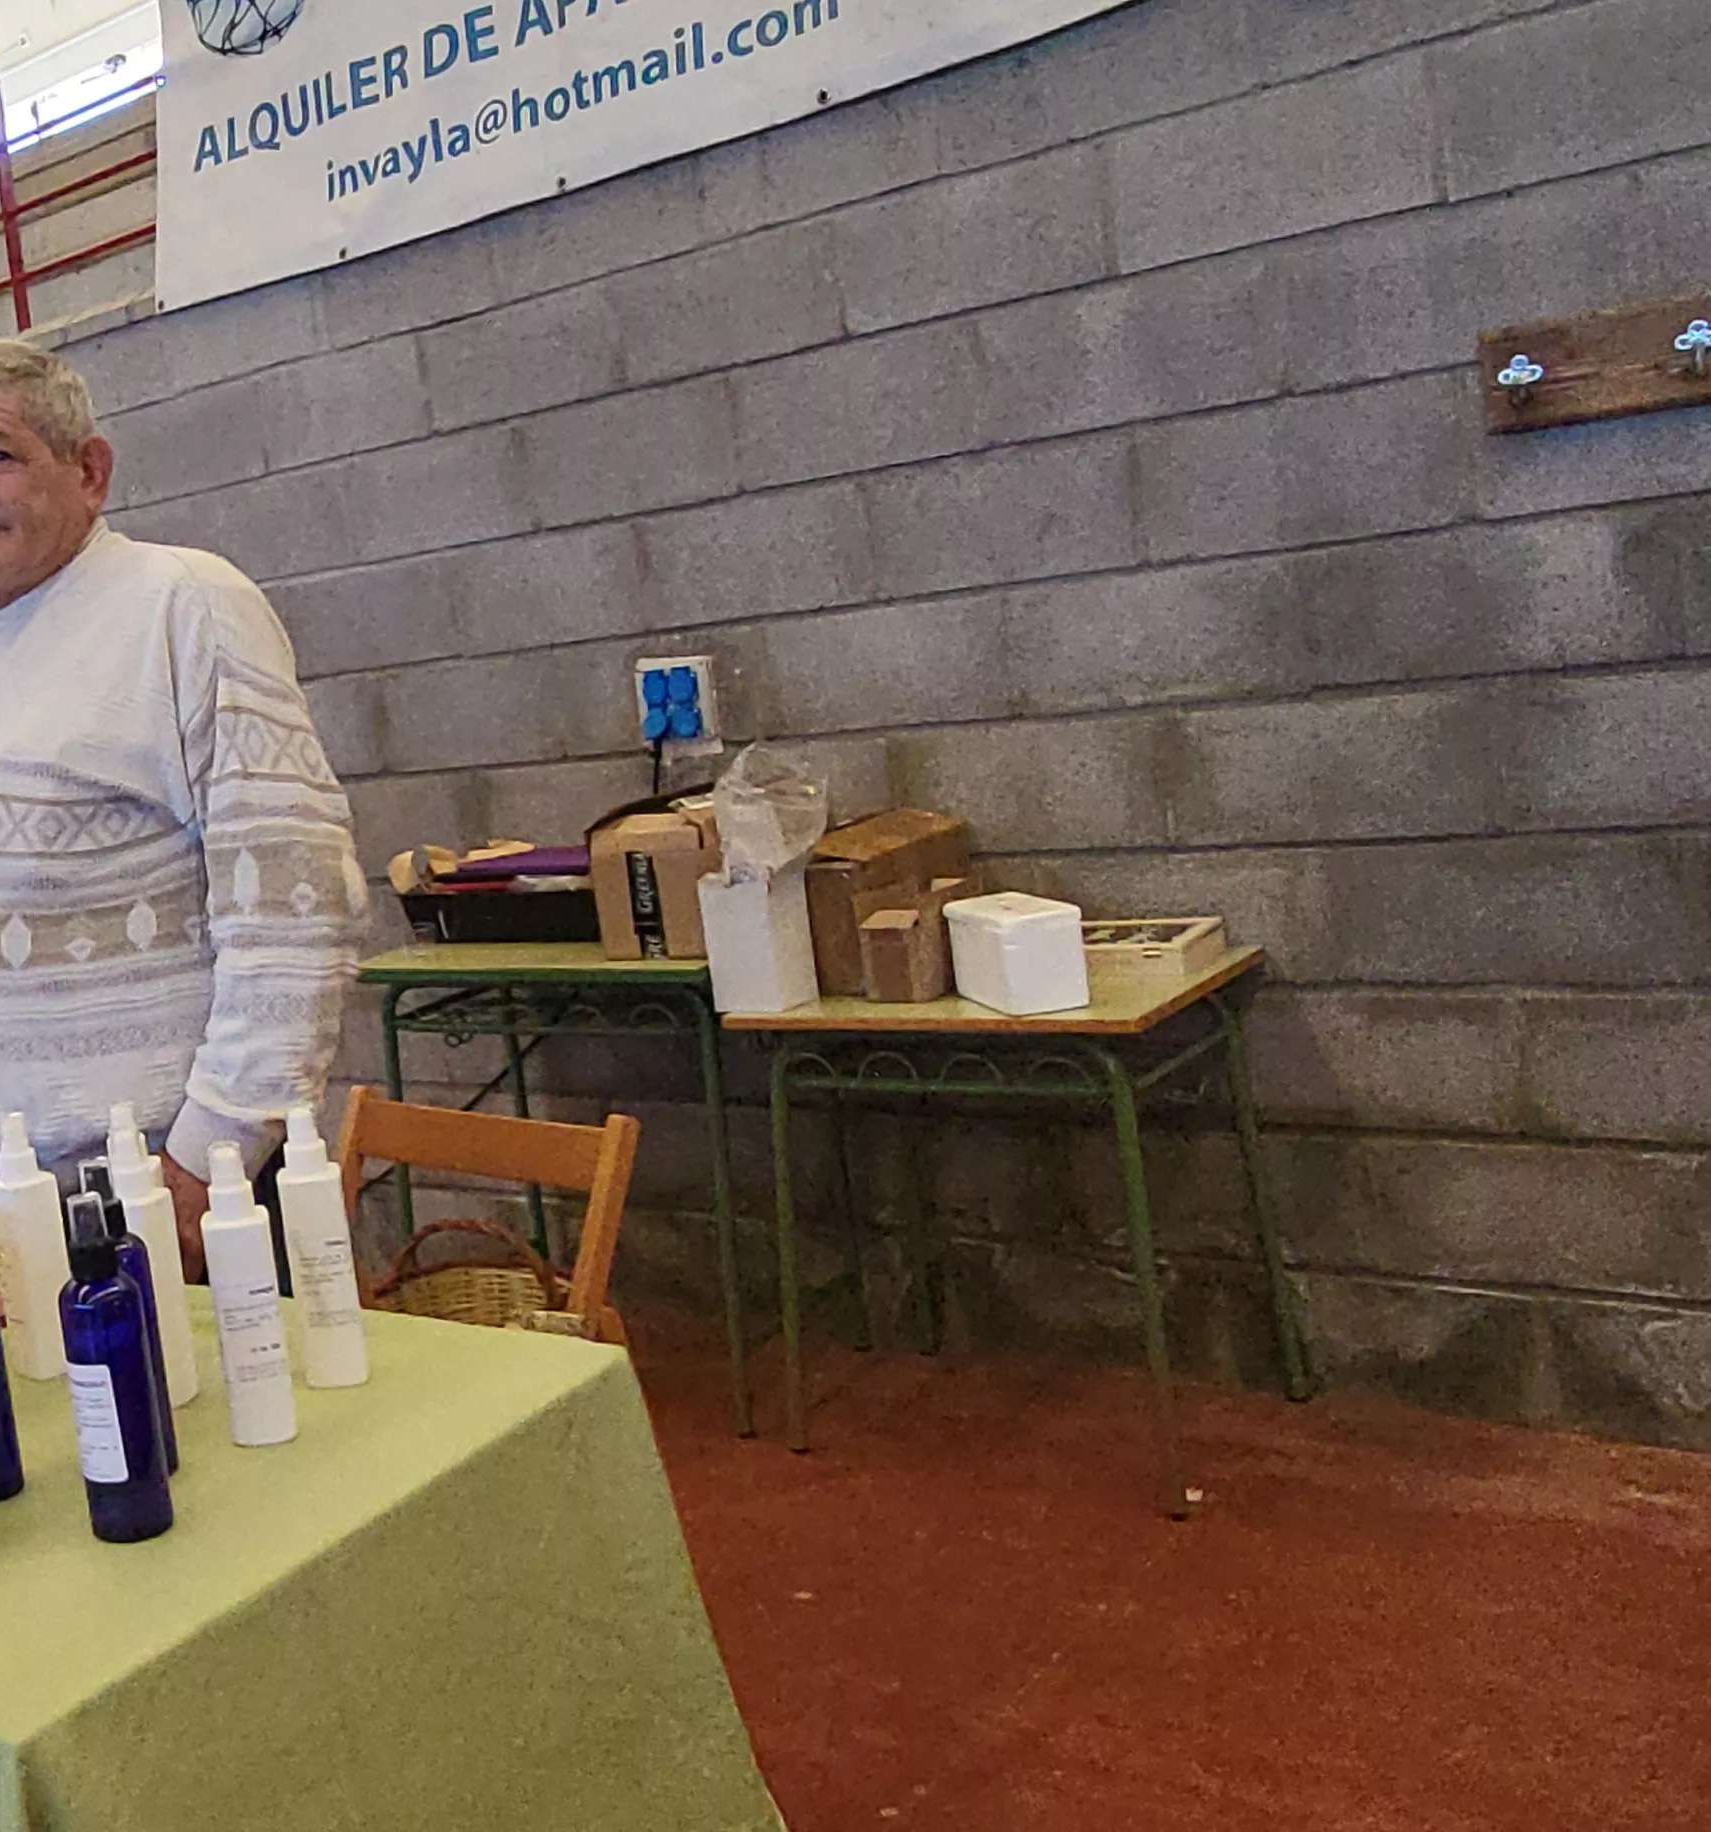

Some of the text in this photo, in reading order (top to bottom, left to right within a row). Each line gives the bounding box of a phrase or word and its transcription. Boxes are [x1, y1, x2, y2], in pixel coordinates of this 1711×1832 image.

[194, 45, 408, 172] ALQUILER
[423, 5, 499, 79] DE
[327, 0, 839, 202] invayla@hotmail.com
